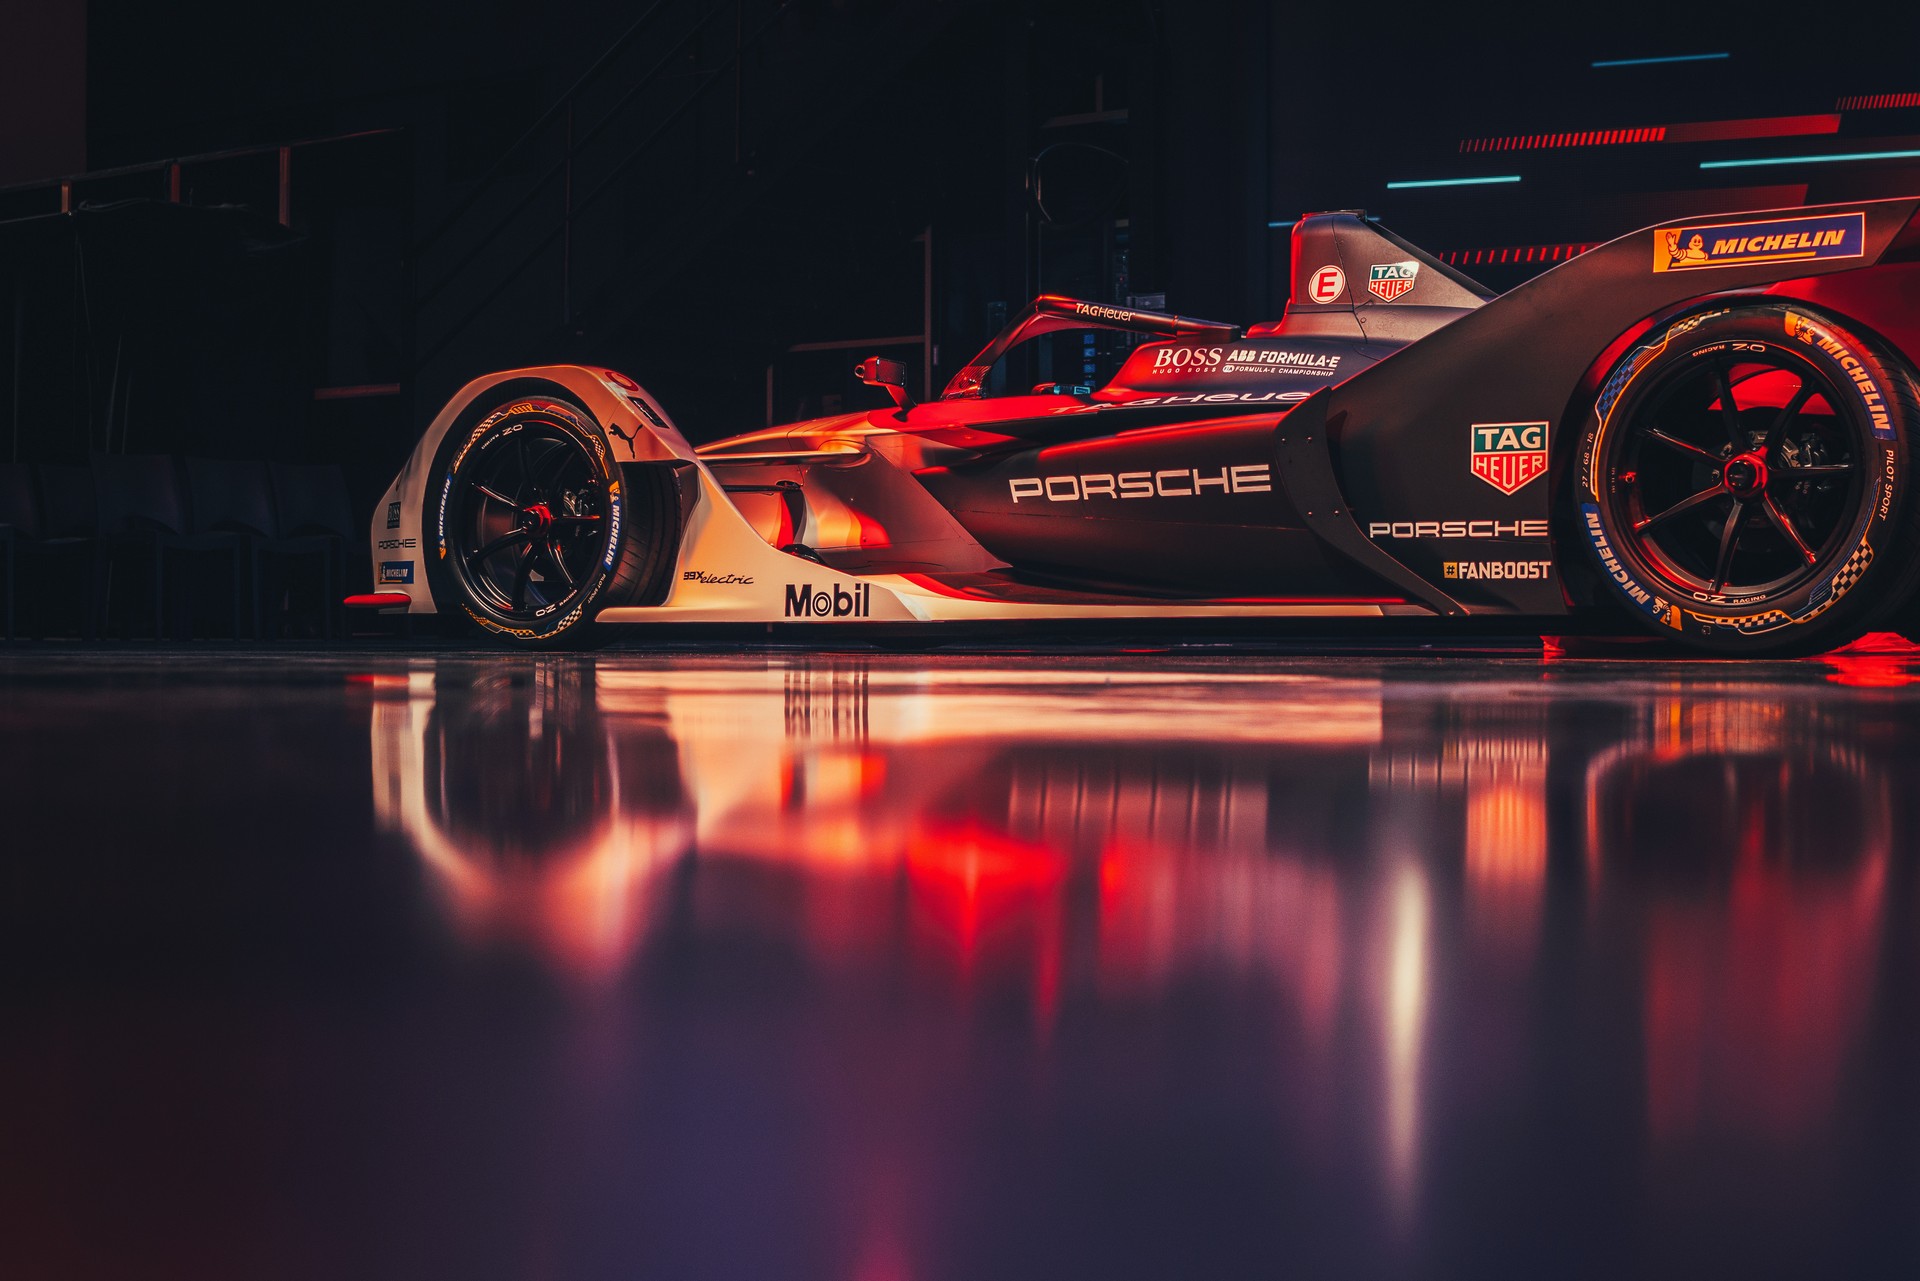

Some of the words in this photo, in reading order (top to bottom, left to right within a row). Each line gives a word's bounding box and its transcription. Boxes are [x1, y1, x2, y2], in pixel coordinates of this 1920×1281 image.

[1711, 229, 1846, 255] MICHELIN
[1374, 266, 1414, 279] TAG
[1318, 271, 1338, 298] E
[1371, 280, 1412, 299] HEUER
[1153, 347, 1223, 368] BOSS
[1226, 350, 1257, 362] ABB
[1152, 367, 1181, 375] HUGO
[1187, 366, 1217, 374] BOSS
[1278, 368, 1334, 377] CHAMPIONSHIP
[1817, 336, 1891, 430] MICHELIN
[1048, 392, 1312, 414] TAGHeue
[1478, 427, 1542, 450] TAG
[1475, 455, 1543, 489] HEUER
[1885, 449, 1894, 482] PILOT
[1008, 464, 1272, 503] PORSCHE
[439, 478, 452, 536] MICHELIN
[1878, 484, 1893, 522] SPORT
[604, 504, 620, 566] MICHELIN
[1369, 520, 1549, 539] PORSCHE
[379, 538, 416, 549] PORSCHE
[1585, 512, 1651, 605] MICHELIN
[386, 568, 408, 577] MICHELIN
[1443, 561, 1552, 579] #FANBOOST
[784, 583, 870, 617] Mobil
[1733, 594, 1766, 604] RACING
